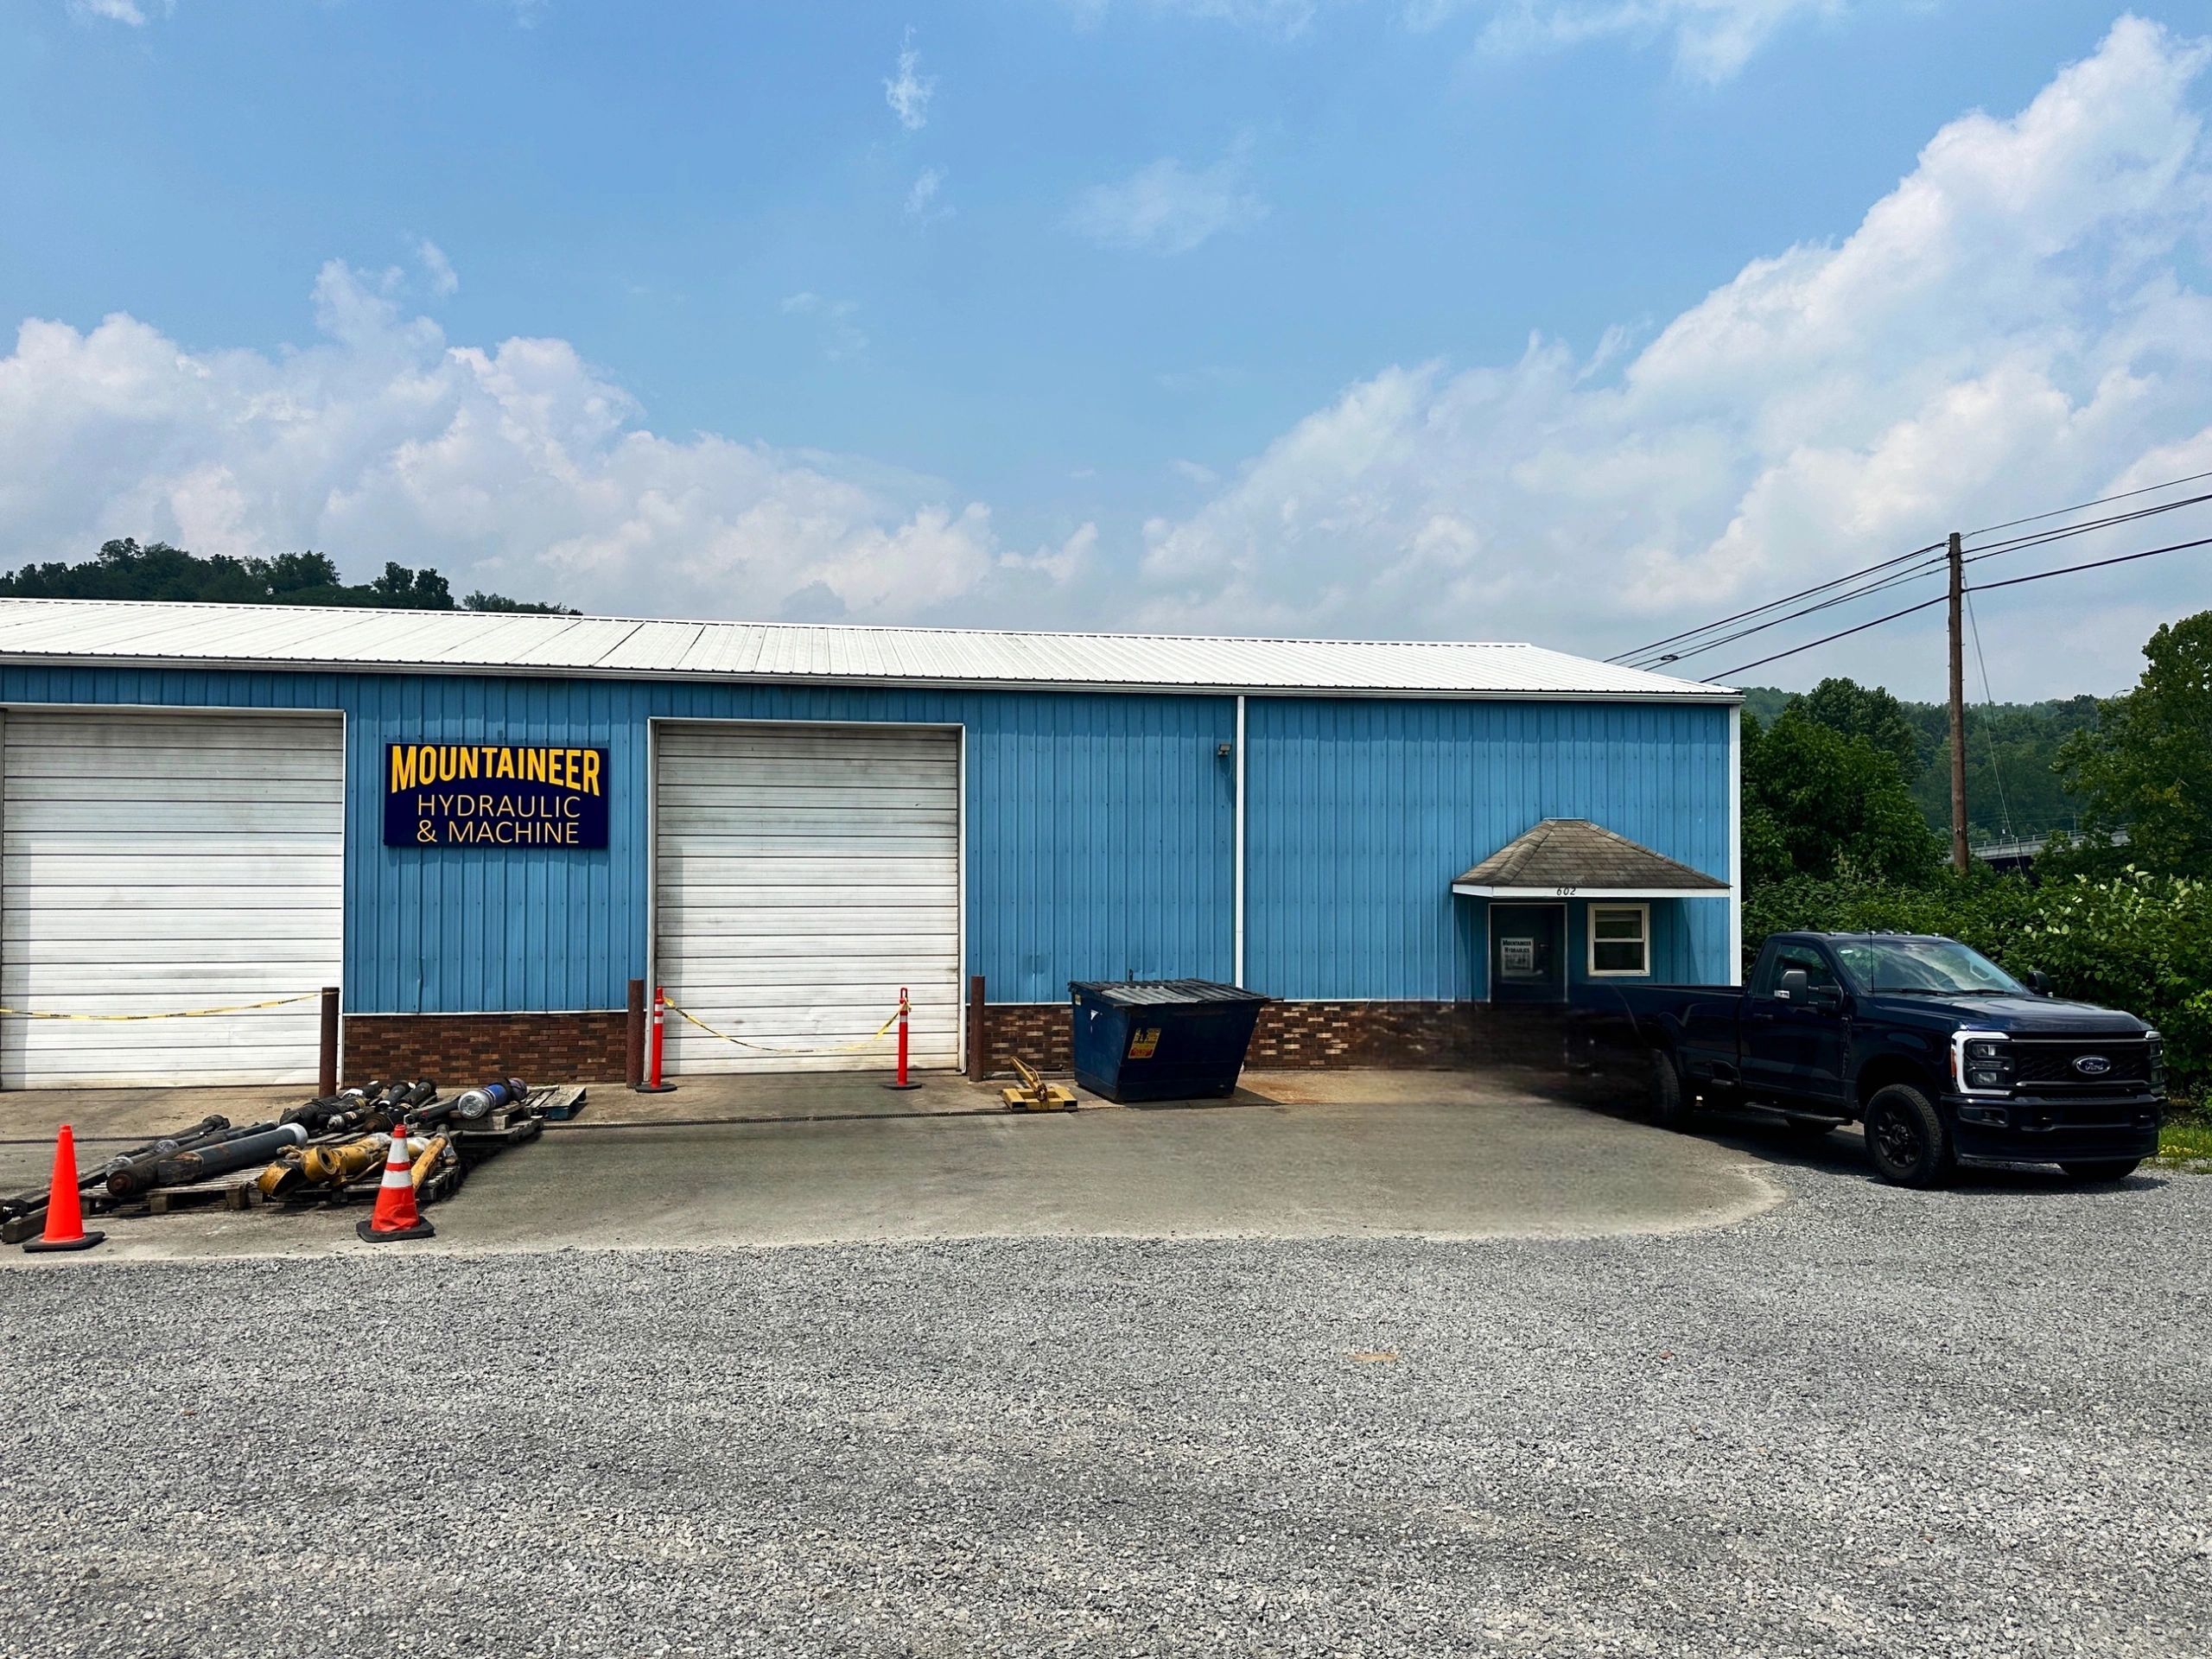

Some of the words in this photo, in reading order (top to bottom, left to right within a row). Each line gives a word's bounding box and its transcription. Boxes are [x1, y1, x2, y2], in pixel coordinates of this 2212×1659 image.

[391, 745, 600, 796] MOUNTAINEER
[418, 794, 581, 817] HYDRAULIC
[416, 819, 437, 842] &
[448, 821, 580, 843] MACHINE
[1556, 886, 1576, 896] 602
